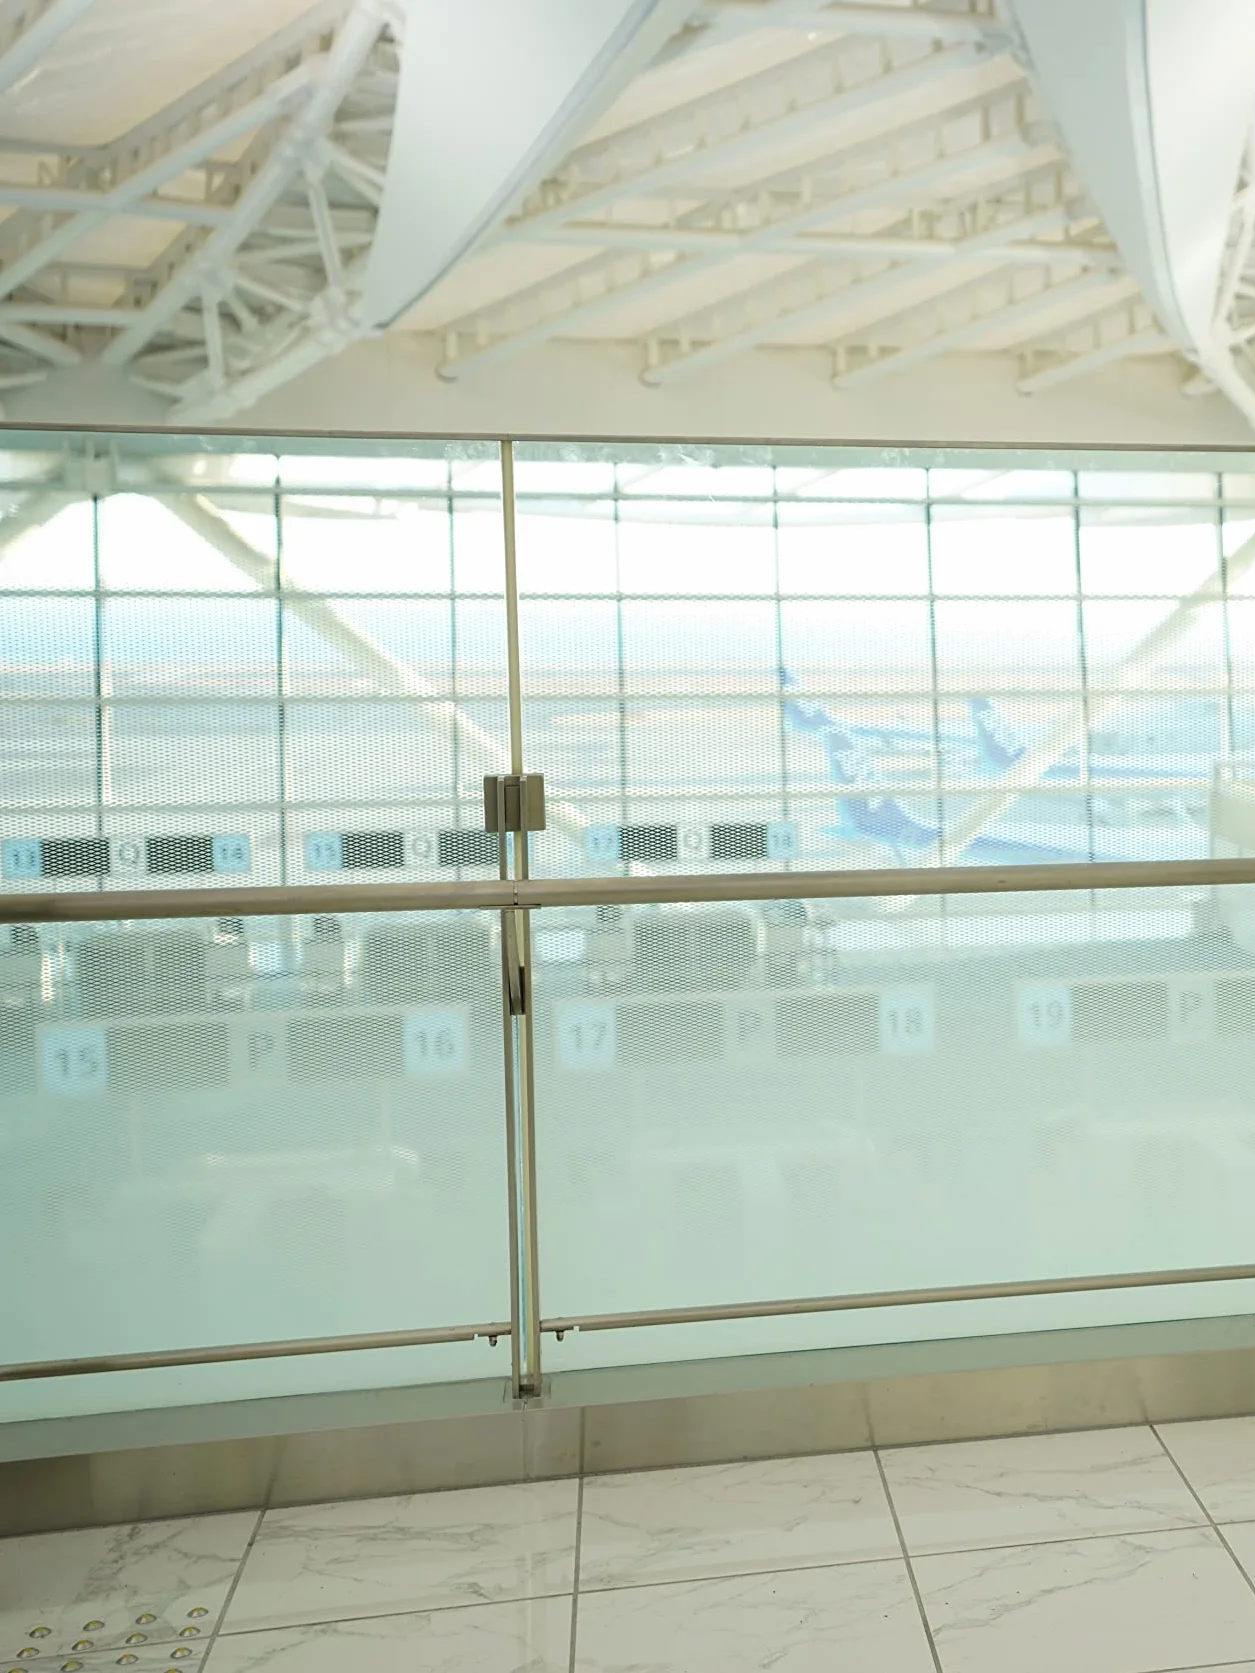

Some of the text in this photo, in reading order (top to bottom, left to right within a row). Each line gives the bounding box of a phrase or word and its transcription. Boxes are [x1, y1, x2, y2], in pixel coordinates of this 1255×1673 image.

[888, 1006, 923, 1037] 18
[1027, 999, 1064, 1030] 19
[1179, 990, 1203, 1024] P
[414, 1027, 456, 1060] 16
[569, 1019, 609, 1053] 17
[736, 1008, 763, 1046] P
[54, 1044, 99, 1079] 15
[248, 1030, 275, 1070] P
